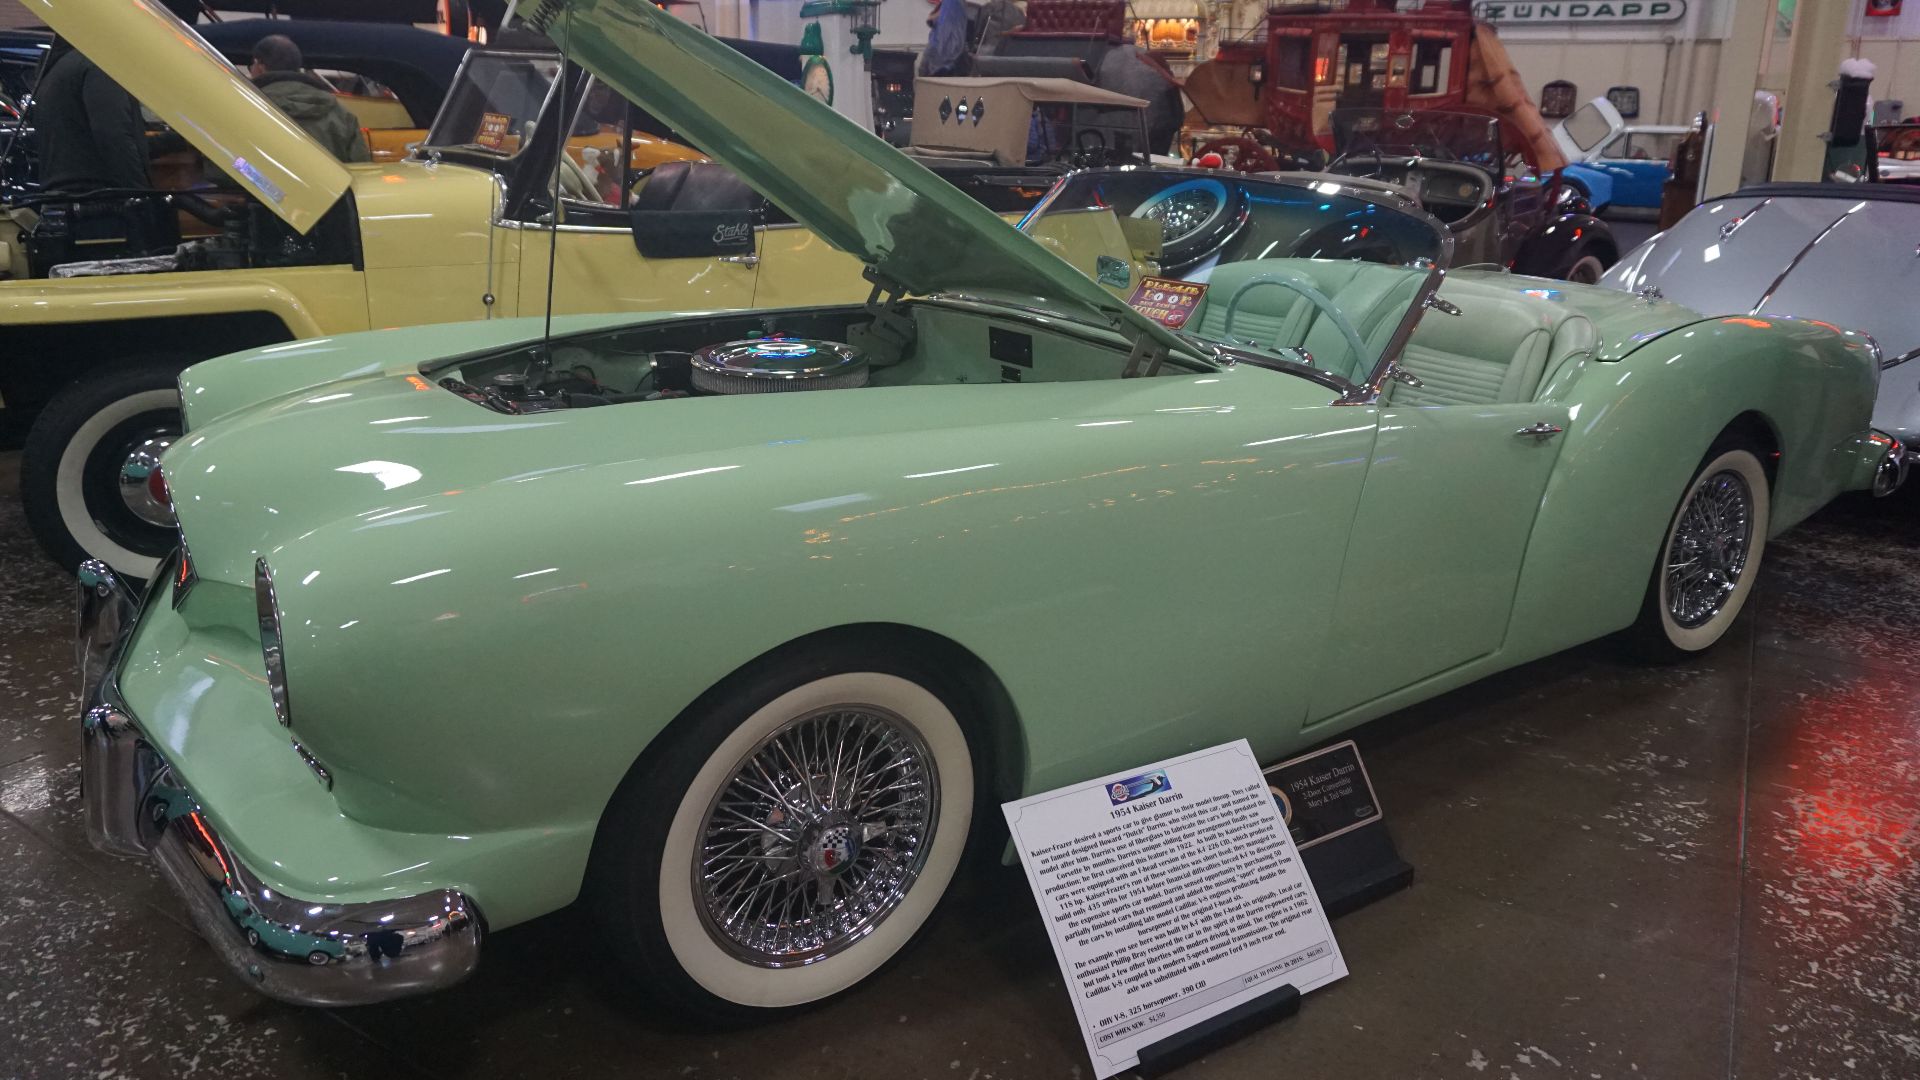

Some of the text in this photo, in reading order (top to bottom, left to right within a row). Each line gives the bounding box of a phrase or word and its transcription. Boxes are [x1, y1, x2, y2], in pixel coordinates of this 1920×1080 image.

[1487, 3, 1672, 18] ZÜNDAPP
[1289, 760, 1355, 792] 1954 Kaiser Darrin
[1110, 791, 1183, 818] 1954 Kaiser Darrin
[1030, 840, 1072, 857] Kaiser-Frazer
[1073, 832, 1096, 844] desired
[1102, 825, 1121, 836] sports
[1049, 850, 1070, 861] famed
[1098, 834, 1122, 846] Howard
[1039, 863, 1059, 875] model
[1059, 859, 1074, 868] after
[1090, 847, 1115, 858] Darrin's
[1056, 867, 1082, 879] Corvette
[1116, 849, 1141, 860] Darrin's
[1090, 870, 1104, 879] first
[1055, 893, 1069, 901] cars
[1070, 887, 1085, 895] were
[1086, 876, 1114, 891] equipped
[1115, 872, 1128, 881] with
[1059, 900, 1073, 910] 118
[1085, 882, 1130, 901] Kaiser-Frazer's
[1131, 878, 1142, 886] run
[1054, 911, 1071, 922] build
[1072, 907, 1086, 917] only
[1087, 901, 1100, 911] 435
[1101, 896, 1117, 906] units
[1129, 886, 1145, 896] 1954
[1068, 920, 1079, 928] the
[1080, 910, 1110, 925] expensive
[1111, 902, 1131, 914] sports
[1064, 926, 1091, 942] partially
[1091, 917, 1117, 931] finished
[1117, 913, 1131, 921] cars
[1131, 907, 1144, 916] that
[1078, 938, 1089, 946] the
[1090, 933, 1104, 942] cars
[1113, 918, 1143, 934] installing
[1142, 914, 1154, 923] late
[1137, 919, 1172, 936] horsepower
[1074, 960, 1086, 969] The
[1087, 950, 1114, 965] example
[1114, 947, 1126, 956] you
[1127, 942, 1138, 950] see
[1138, 936, 1153, 946] here
[1154, 932, 1166, 940] was
[1076, 962, 1110, 979] enthusiast
[1110, 955, 1131, 968] Phillip
[1131, 949, 1146, 960] Bray
[1147, 939, 1173, 953] restored
[1082, 979, 1094, 988] but
[1095, 973, 1110, 983] took
[1116, 967, 1127, 975] few
[1128, 960, 1145, 971] other
[1146, 951, 1171, 964] liberties
[1085, 984, 1111, 998] Cadillac
[1111, 979, 1122, 988] V-8
[1123, 969, 1148, 984] coupled
[1126, 985, 1139, 994] axle
[1140, 980, 1152, 988] was
[1153, 965, 1187, 983] substituted
[1099, 1016, 1113, 1027] OHV
[1128, 1004, 1141, 1015] 325
[1142, 990, 1181, 1010] horsepower,
[1181, 984, 1194, 994] 390
